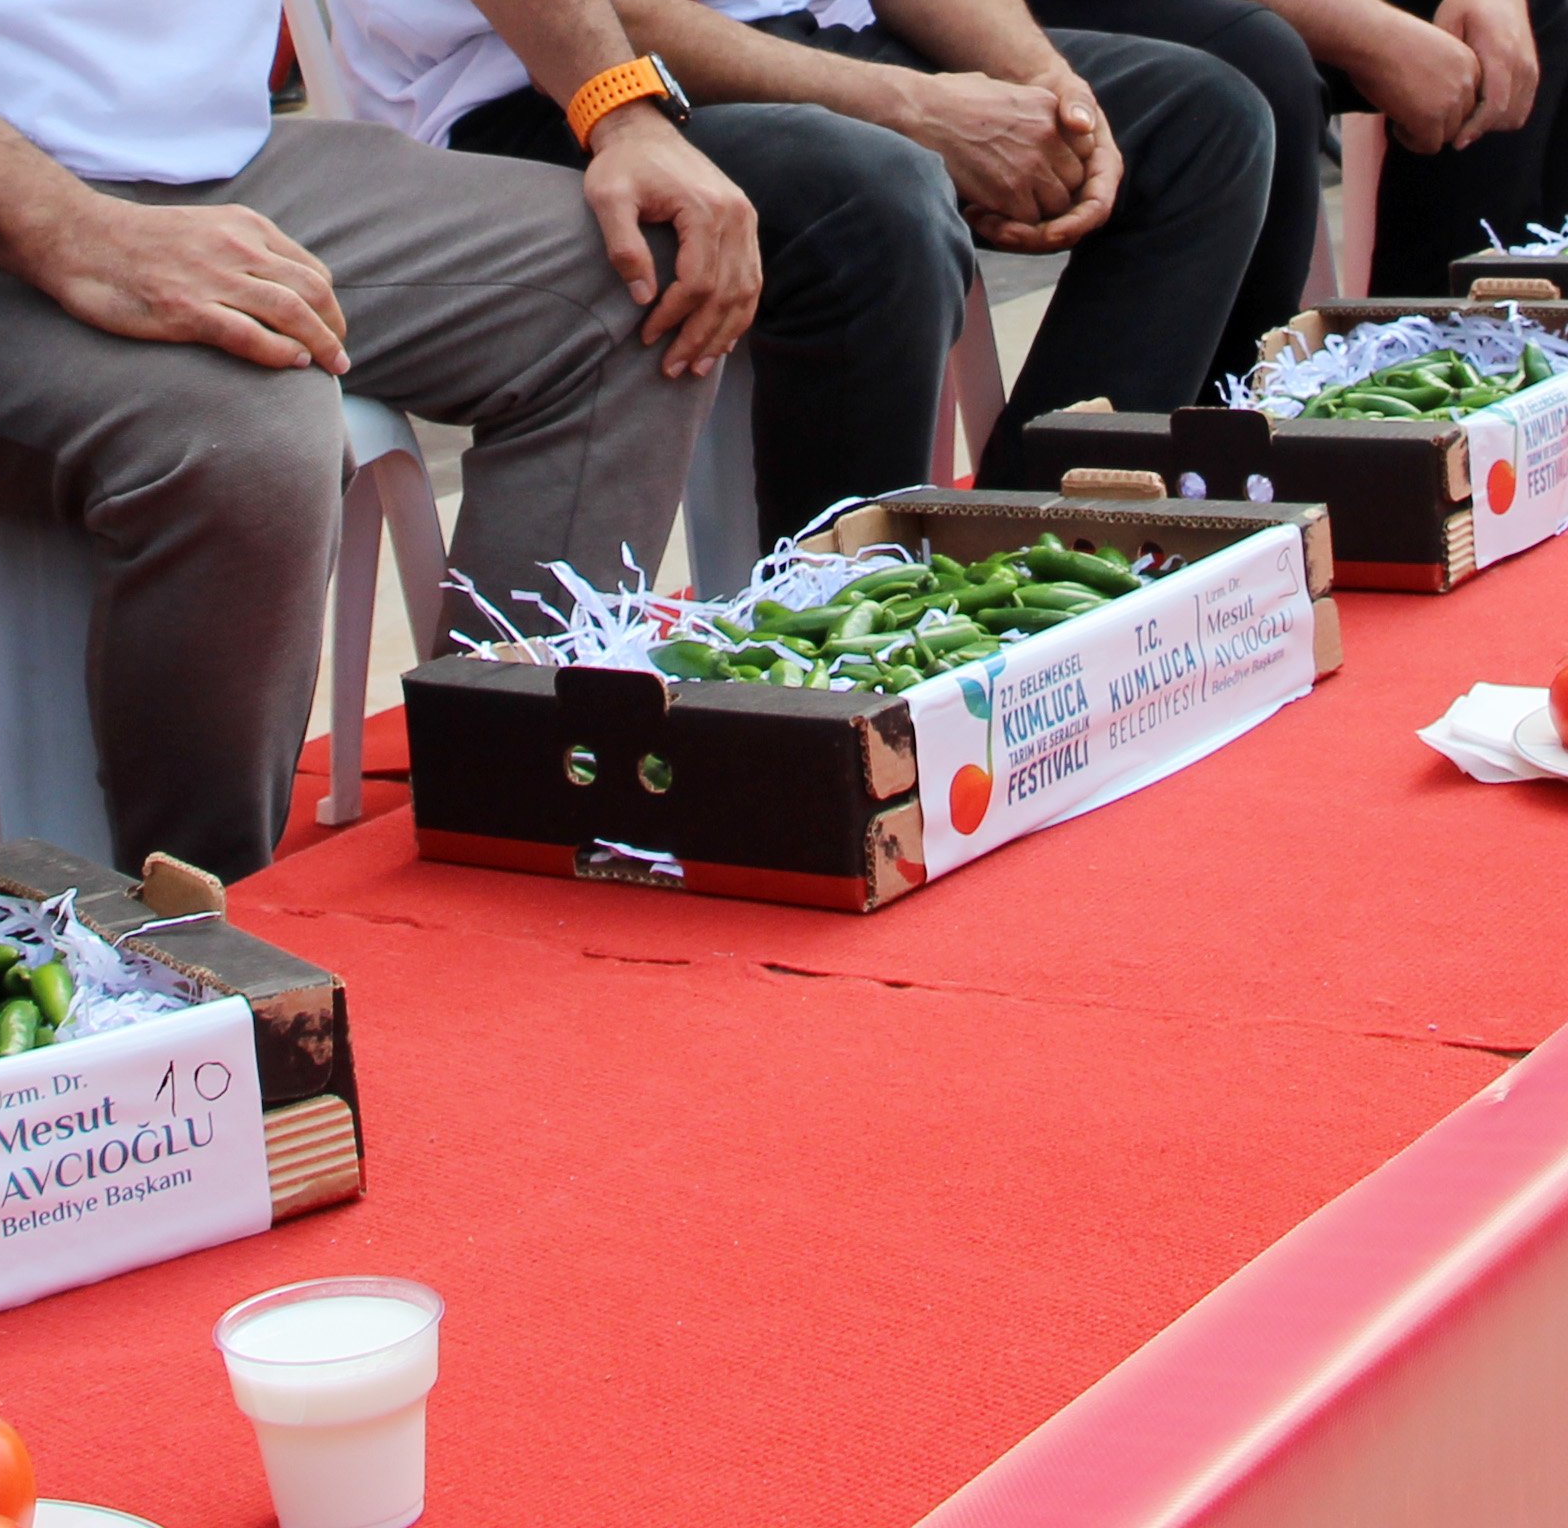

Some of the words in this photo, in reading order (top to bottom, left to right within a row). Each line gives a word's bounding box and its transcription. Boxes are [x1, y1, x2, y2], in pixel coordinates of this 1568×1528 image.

[1277, 547, 1299, 599] 9
[1134, 618, 1163, 657] T.C.
[1205, 595, 1255, 638] Mesut
[1213, 608, 1295, 672] AVCIOĞLU
[1000, 685, 1018, 710] 27.
[1019, 653, 1084, 700] GELENEKSEL
[1109, 641, 1197, 714] KUMLUCA
[1002, 678, 1089, 748] KUMLUCA
[1007, 742, 1034, 768] TARIM
[1036, 737, 1048, 755] VE
[1049, 716, 1090, 751] SERACILIK
[1109, 674, 1197, 750] BELEDİYESİ
[1007, 736, 1090, 806] FESTİVALİ
[52, 1073, 89, 1097] Dr.
[153, 1060, 232, 1117] 10
[0, 1110, 215, 1209] AVCIOĞLU
[1, 1194, 99, 1239] Belediye
[104, 1166, 193, 1206] Başkanı
